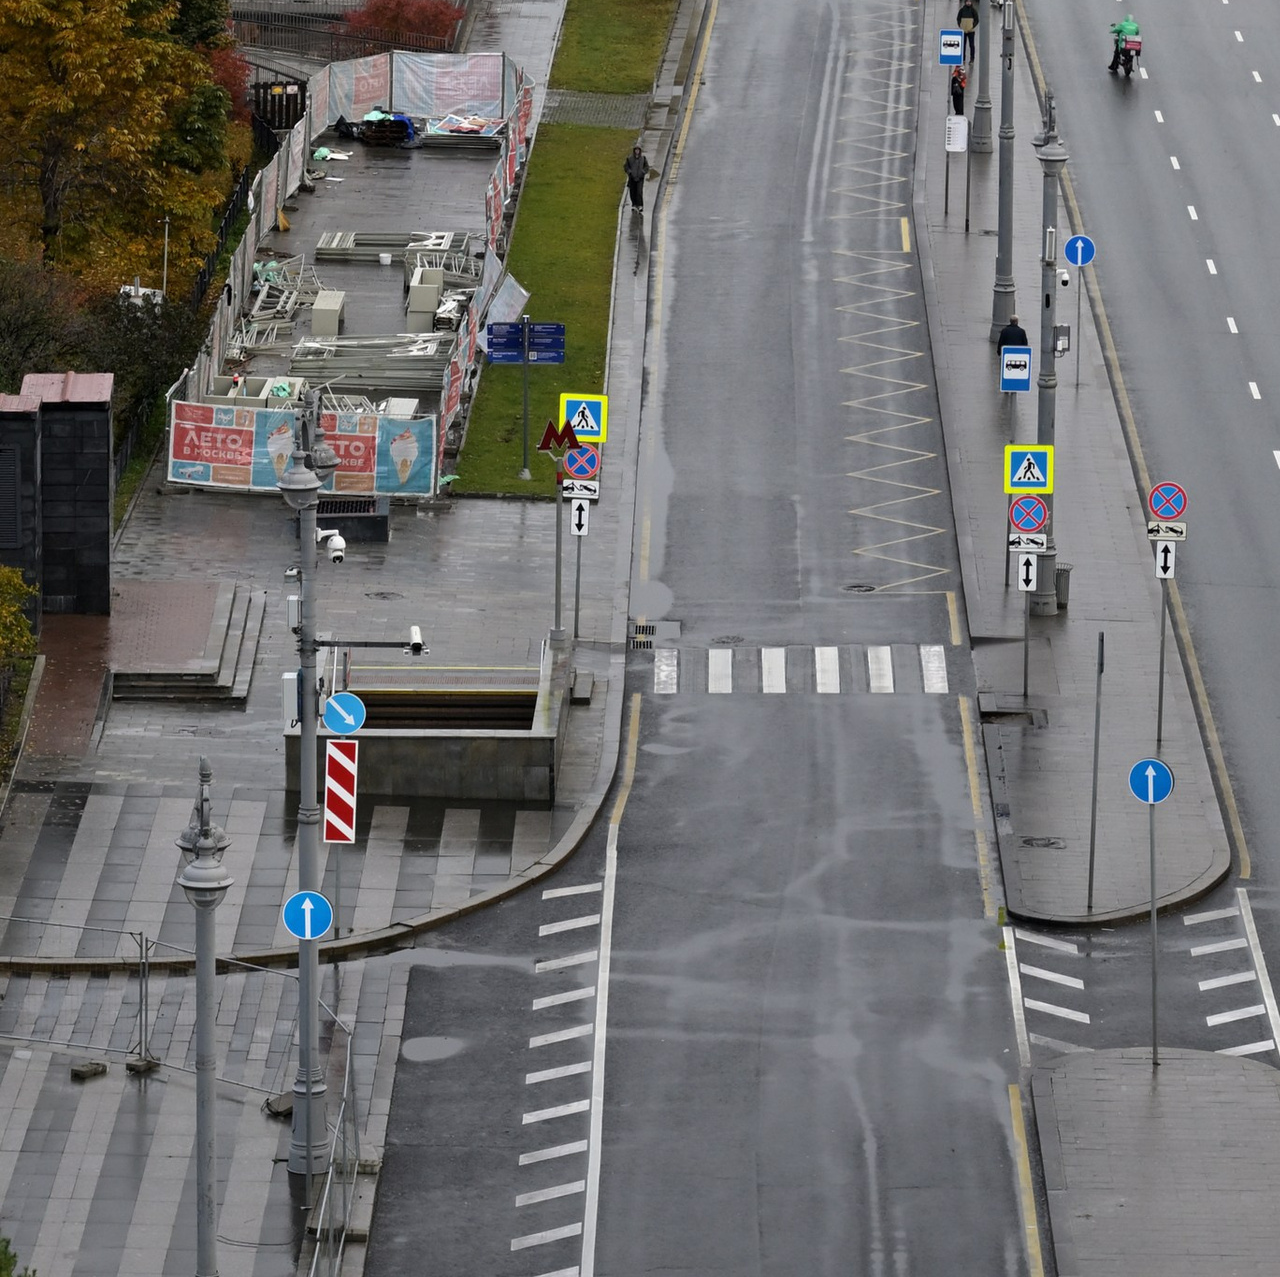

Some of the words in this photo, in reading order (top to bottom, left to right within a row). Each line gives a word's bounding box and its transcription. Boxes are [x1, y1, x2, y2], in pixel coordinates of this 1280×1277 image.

[184, 430, 242, 449] ЛЕТО
[537, 419, 582, 451] М
[183, 446, 191, 455] В
[194, 448, 241, 459] МОСКВЕ
